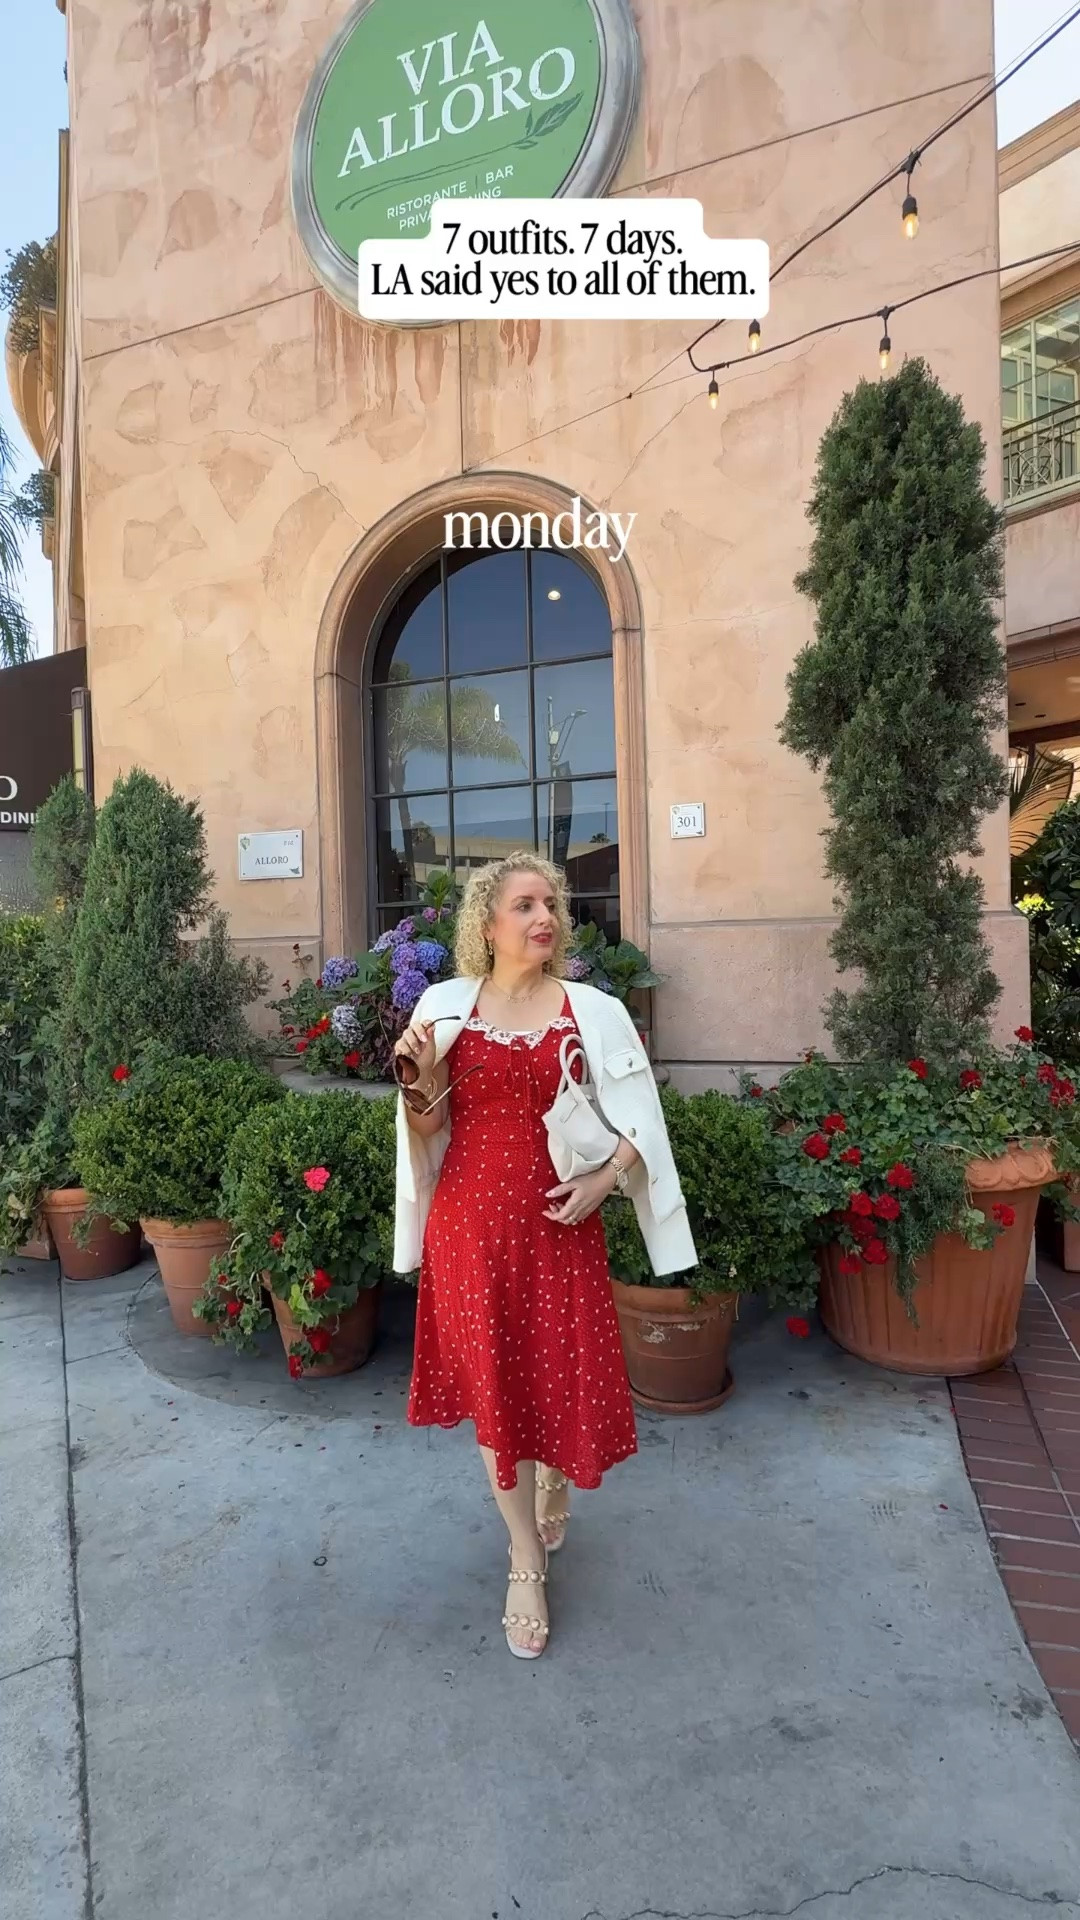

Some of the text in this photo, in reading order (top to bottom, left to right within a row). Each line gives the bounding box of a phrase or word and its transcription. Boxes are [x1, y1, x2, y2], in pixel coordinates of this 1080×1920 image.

[397, 20, 504, 95] VIA
[337, 47, 576, 178] ALLORO
[387, 165, 514, 219] RISTORANTE BAR
[0, 811, 39, 824] DINI
[677, 816, 697, 828] 301
[255, 855, 289, 866] ALLORO
